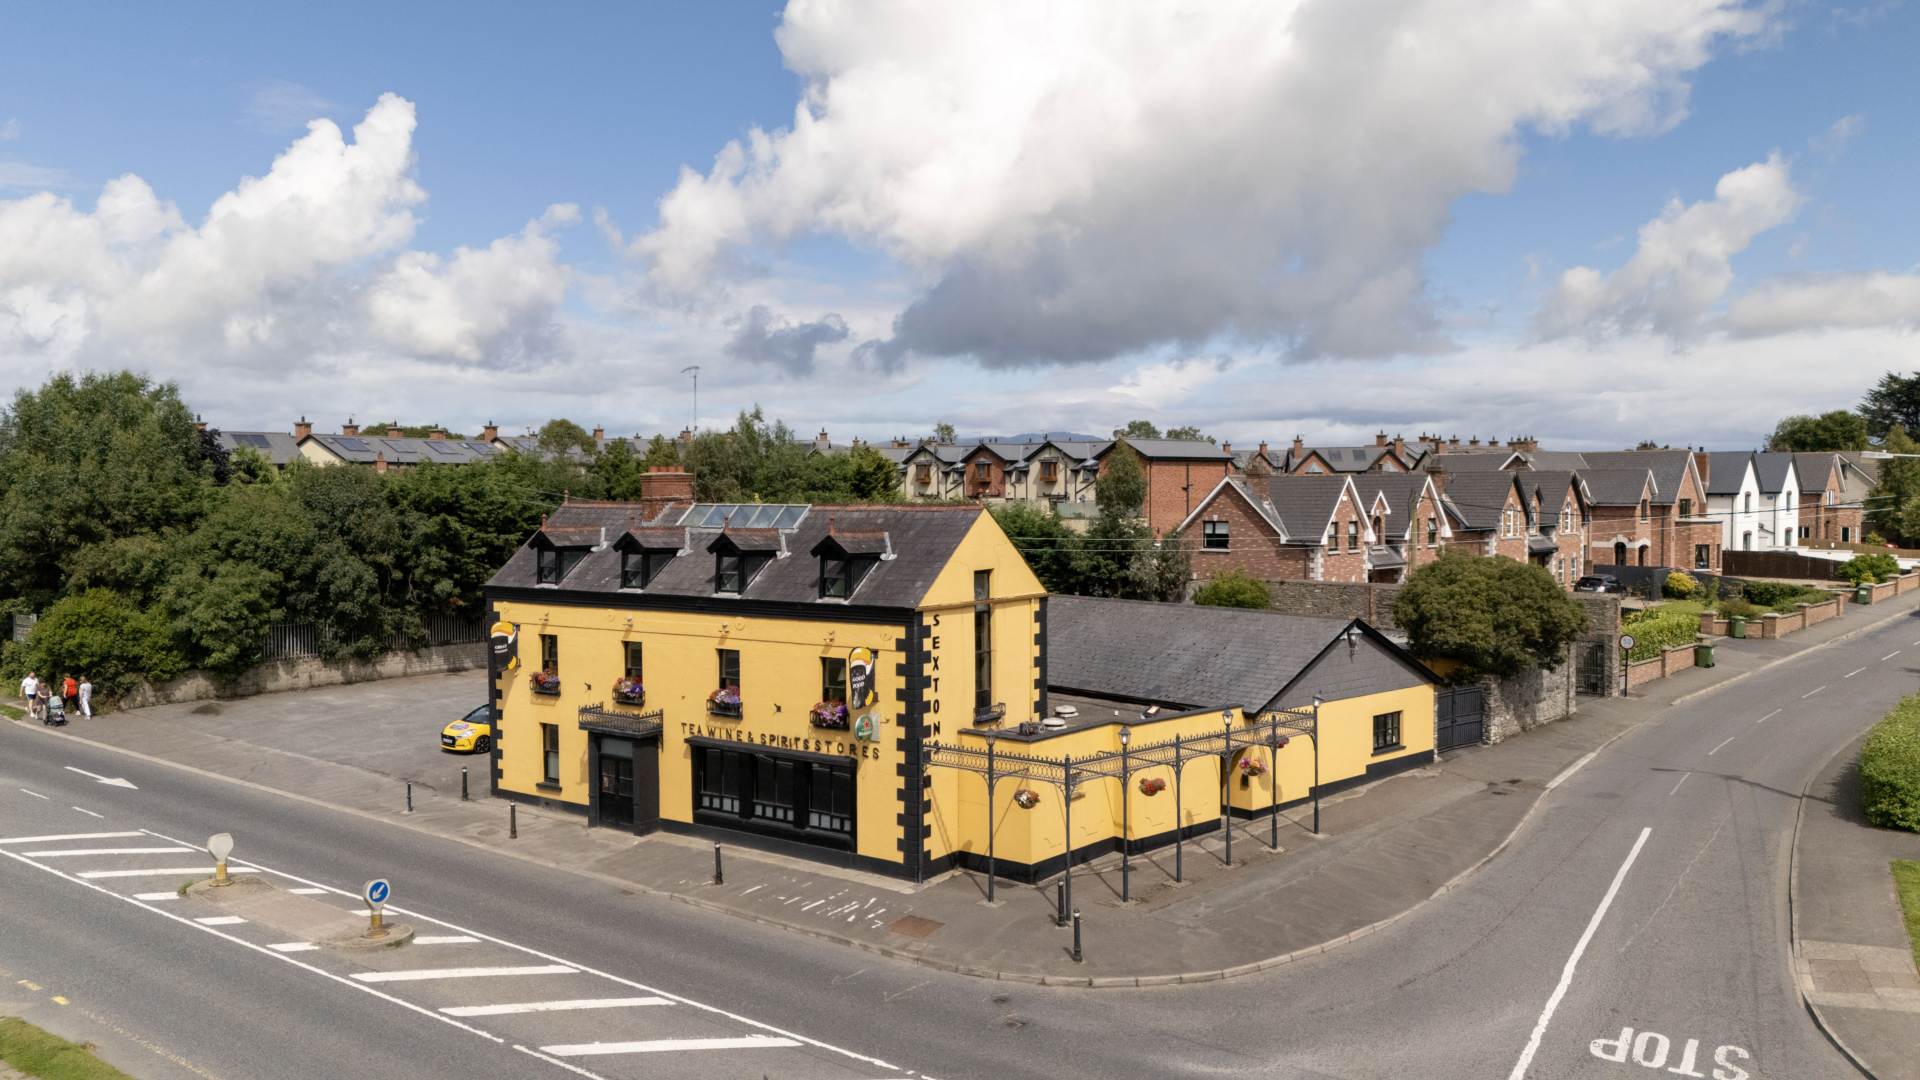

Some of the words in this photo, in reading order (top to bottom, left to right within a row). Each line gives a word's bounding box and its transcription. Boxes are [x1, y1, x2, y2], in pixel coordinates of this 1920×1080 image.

[681, 722, 703, 737] TEA
[707, 725, 743, 743] WINE
[747, 733, 755, 744] &
[760, 733, 809, 750] SPIRITS
[814, 740, 880, 760] STORES
[1589, 1026, 1750, 1080] STOP
